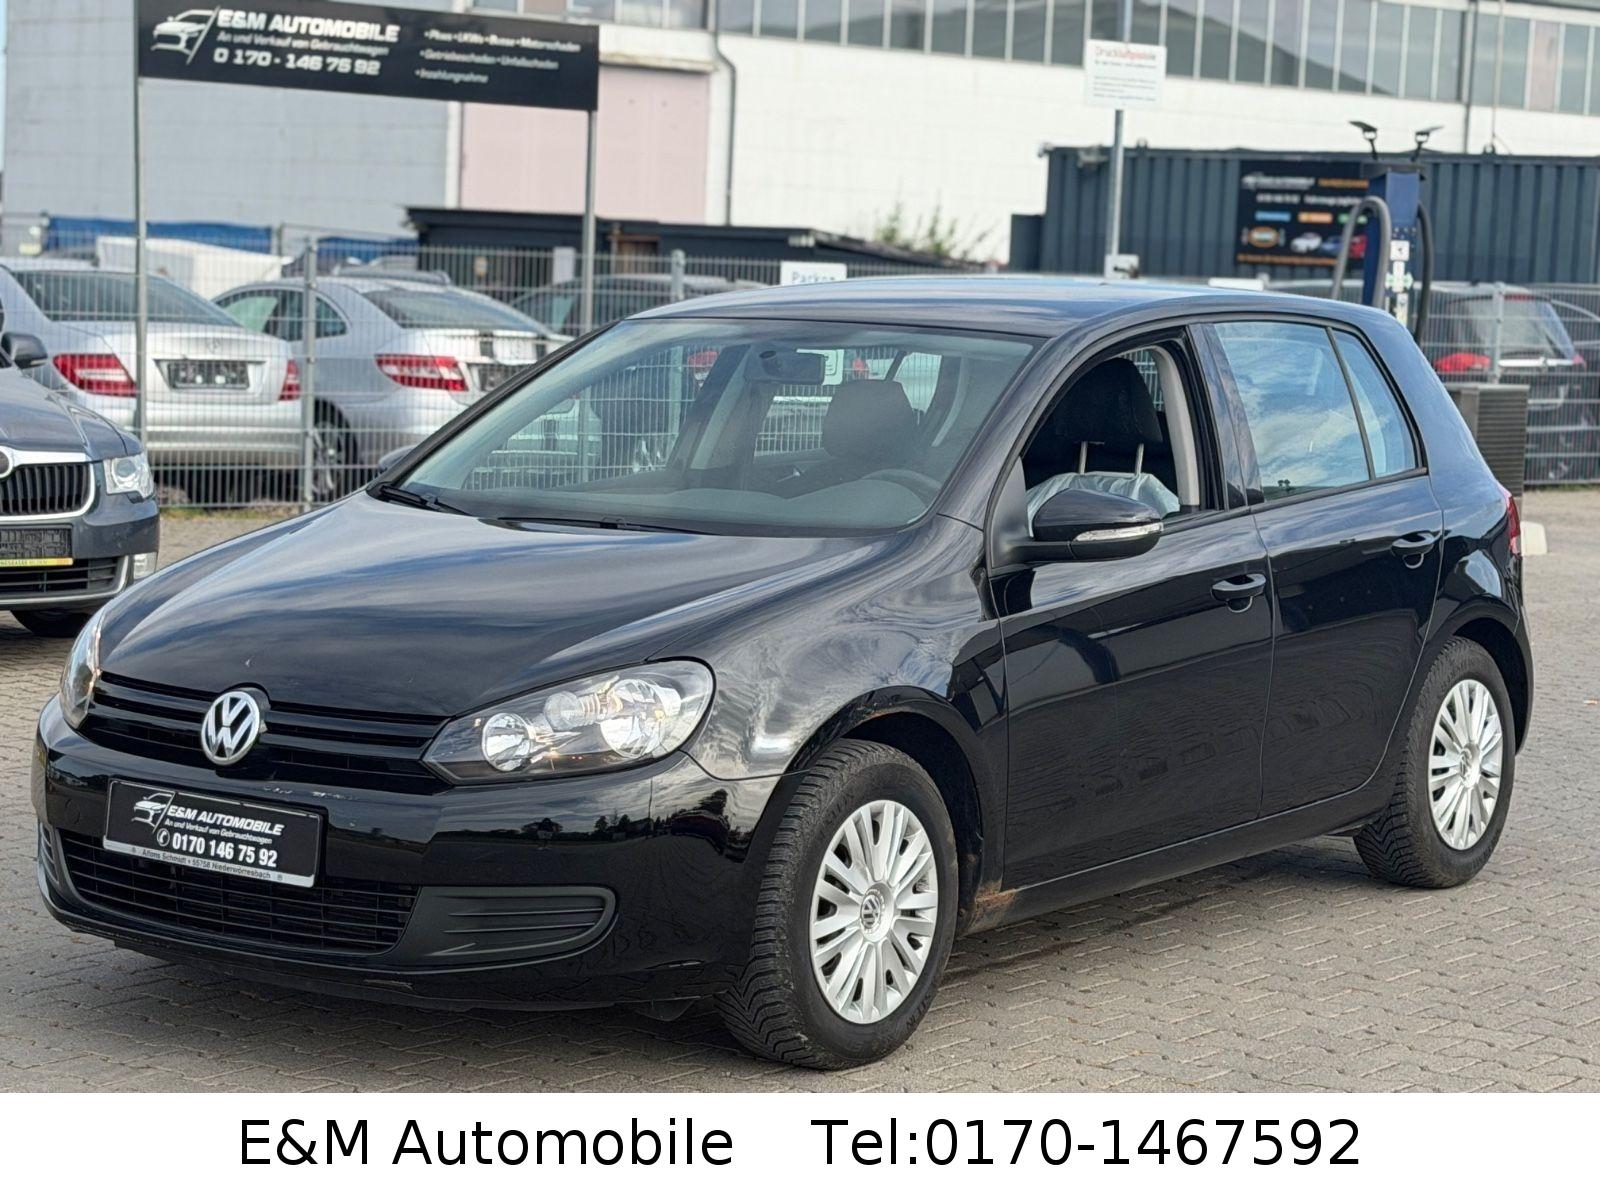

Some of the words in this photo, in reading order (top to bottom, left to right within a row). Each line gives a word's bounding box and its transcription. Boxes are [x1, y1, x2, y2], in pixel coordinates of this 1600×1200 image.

[217, 9, 267, 31] E&M
[268, 14, 401, 43] AUTOMOBILE
[217, 31, 231, 43] An
[233, 32, 251, 45] und
[254, 33, 291, 48] Verkauf
[213, 47, 230, 64] 0
[233, 48, 271, 67] 170
[285, 53, 323, 72] 146
[325, 56, 351, 74] 75
[353, 58, 382, 76] 92
[164, 819, 174, 828] An
[174, 820, 186, 830] und
[186, 822, 209, 834] Verkauf
[209, 828, 220, 836] von
[220, 828, 273, 845] Gebrauchtwagen
[167, 805, 198, 820] E&M
[197, 811, 285, 836] AUTOMOBILE
[172, 832, 206, 855] 0170
[208, 840, 234, 861] 146
[238, 845, 256, 864] 75
[258, 850, 279, 868] 92
